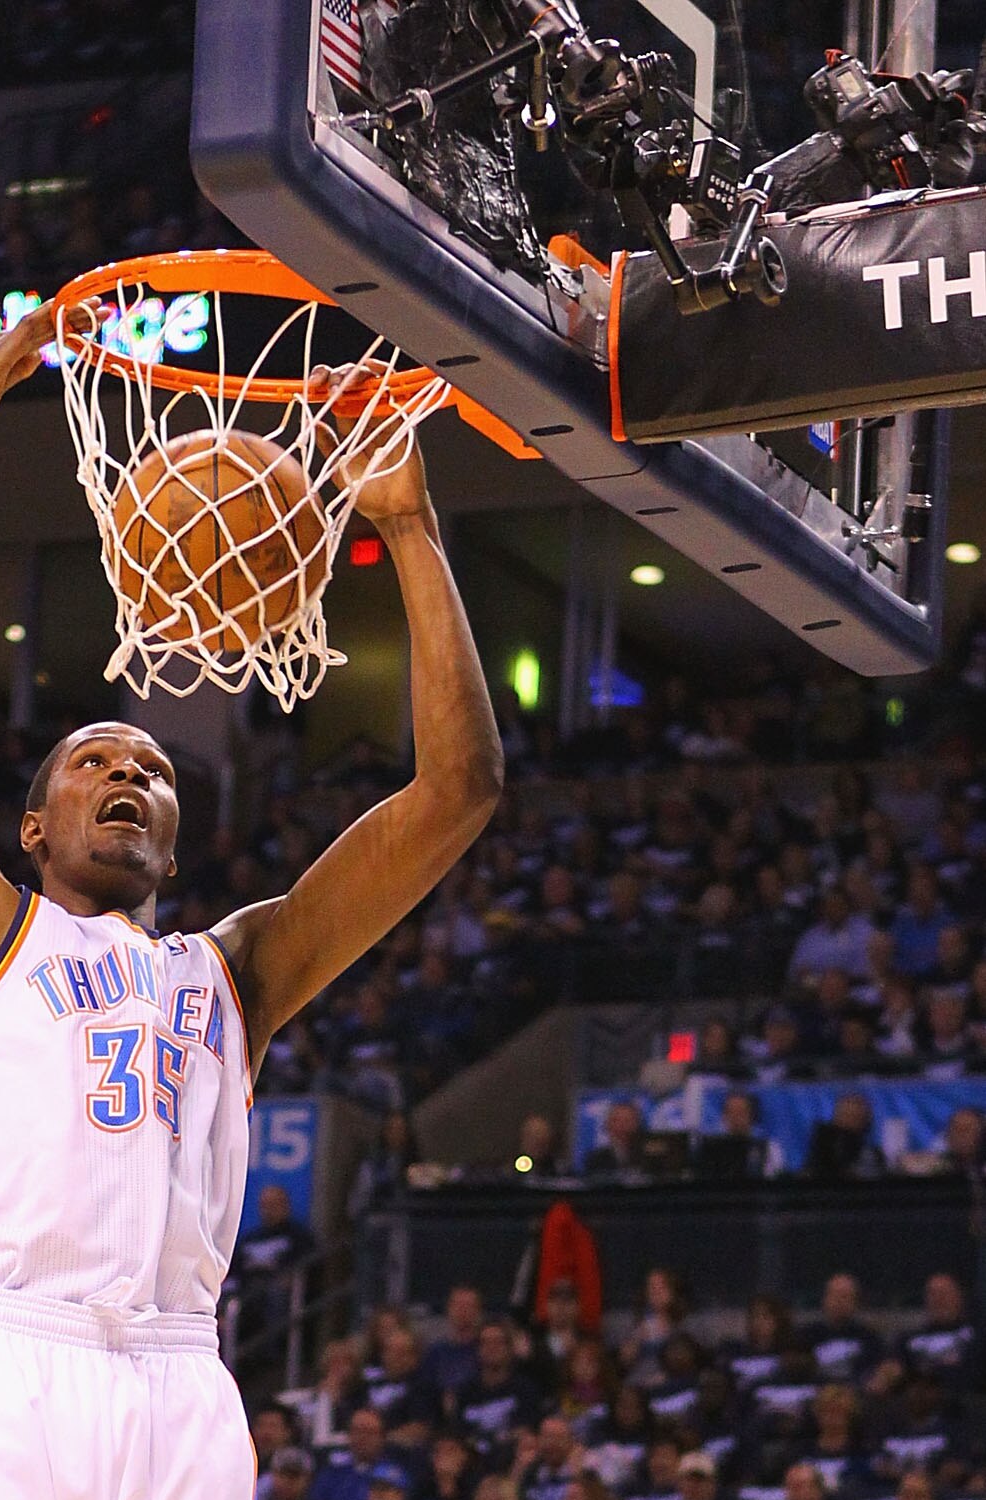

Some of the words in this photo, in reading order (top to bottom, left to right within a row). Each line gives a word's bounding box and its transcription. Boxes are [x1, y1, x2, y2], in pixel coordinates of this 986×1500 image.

[862, 249, 986, 331] TH
[26, 943, 226, 1066] THUNER
[85, 1023, 189, 1143] 35
